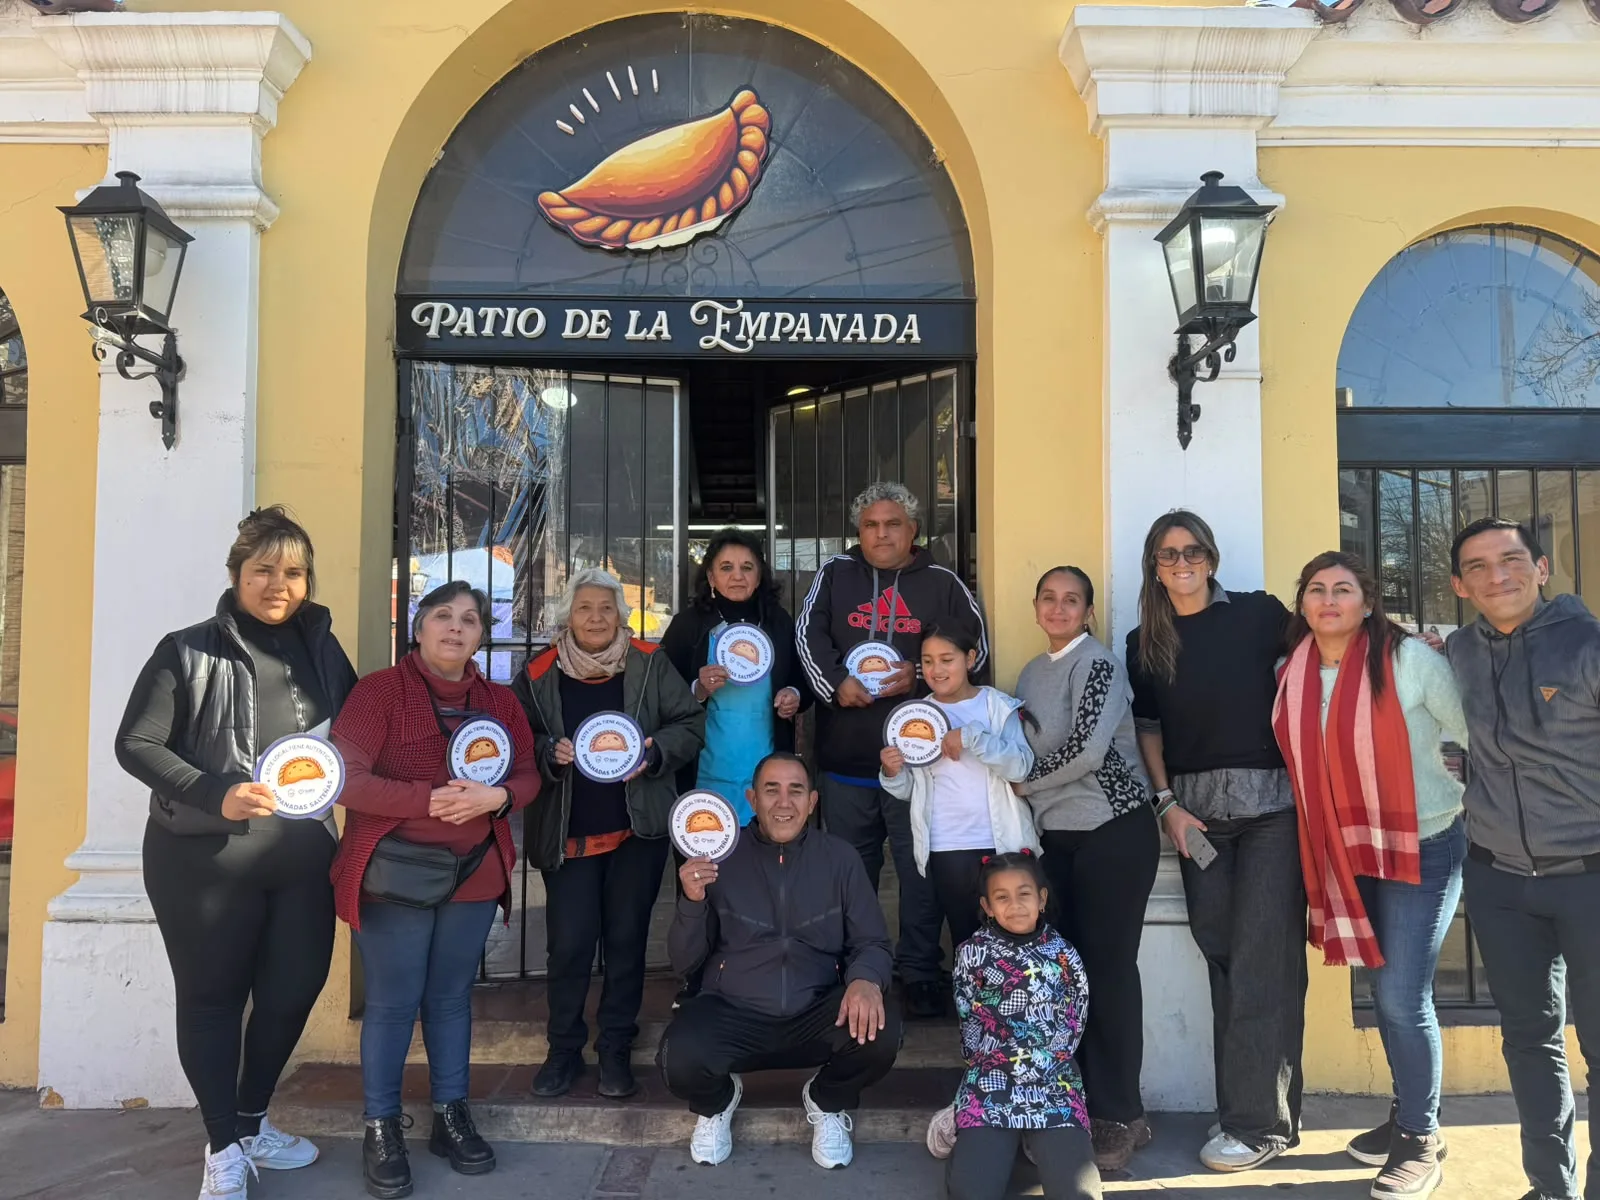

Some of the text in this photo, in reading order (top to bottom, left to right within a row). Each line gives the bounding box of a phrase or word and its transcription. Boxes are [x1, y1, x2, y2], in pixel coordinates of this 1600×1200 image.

[411, 299, 921, 353] PATIO DE LA EMPANADA
[462, 730, 474, 741] LOCAL
[581, 730, 589, 741] ESTE
[588, 722, 602, 731] LOCAL
[265, 760, 274, 775] ESTE
[273, 747, 289, 762] LOCAL
[582, 754, 609, 775] EMPANADAS
[682, 802, 694, 811] LOCAL
